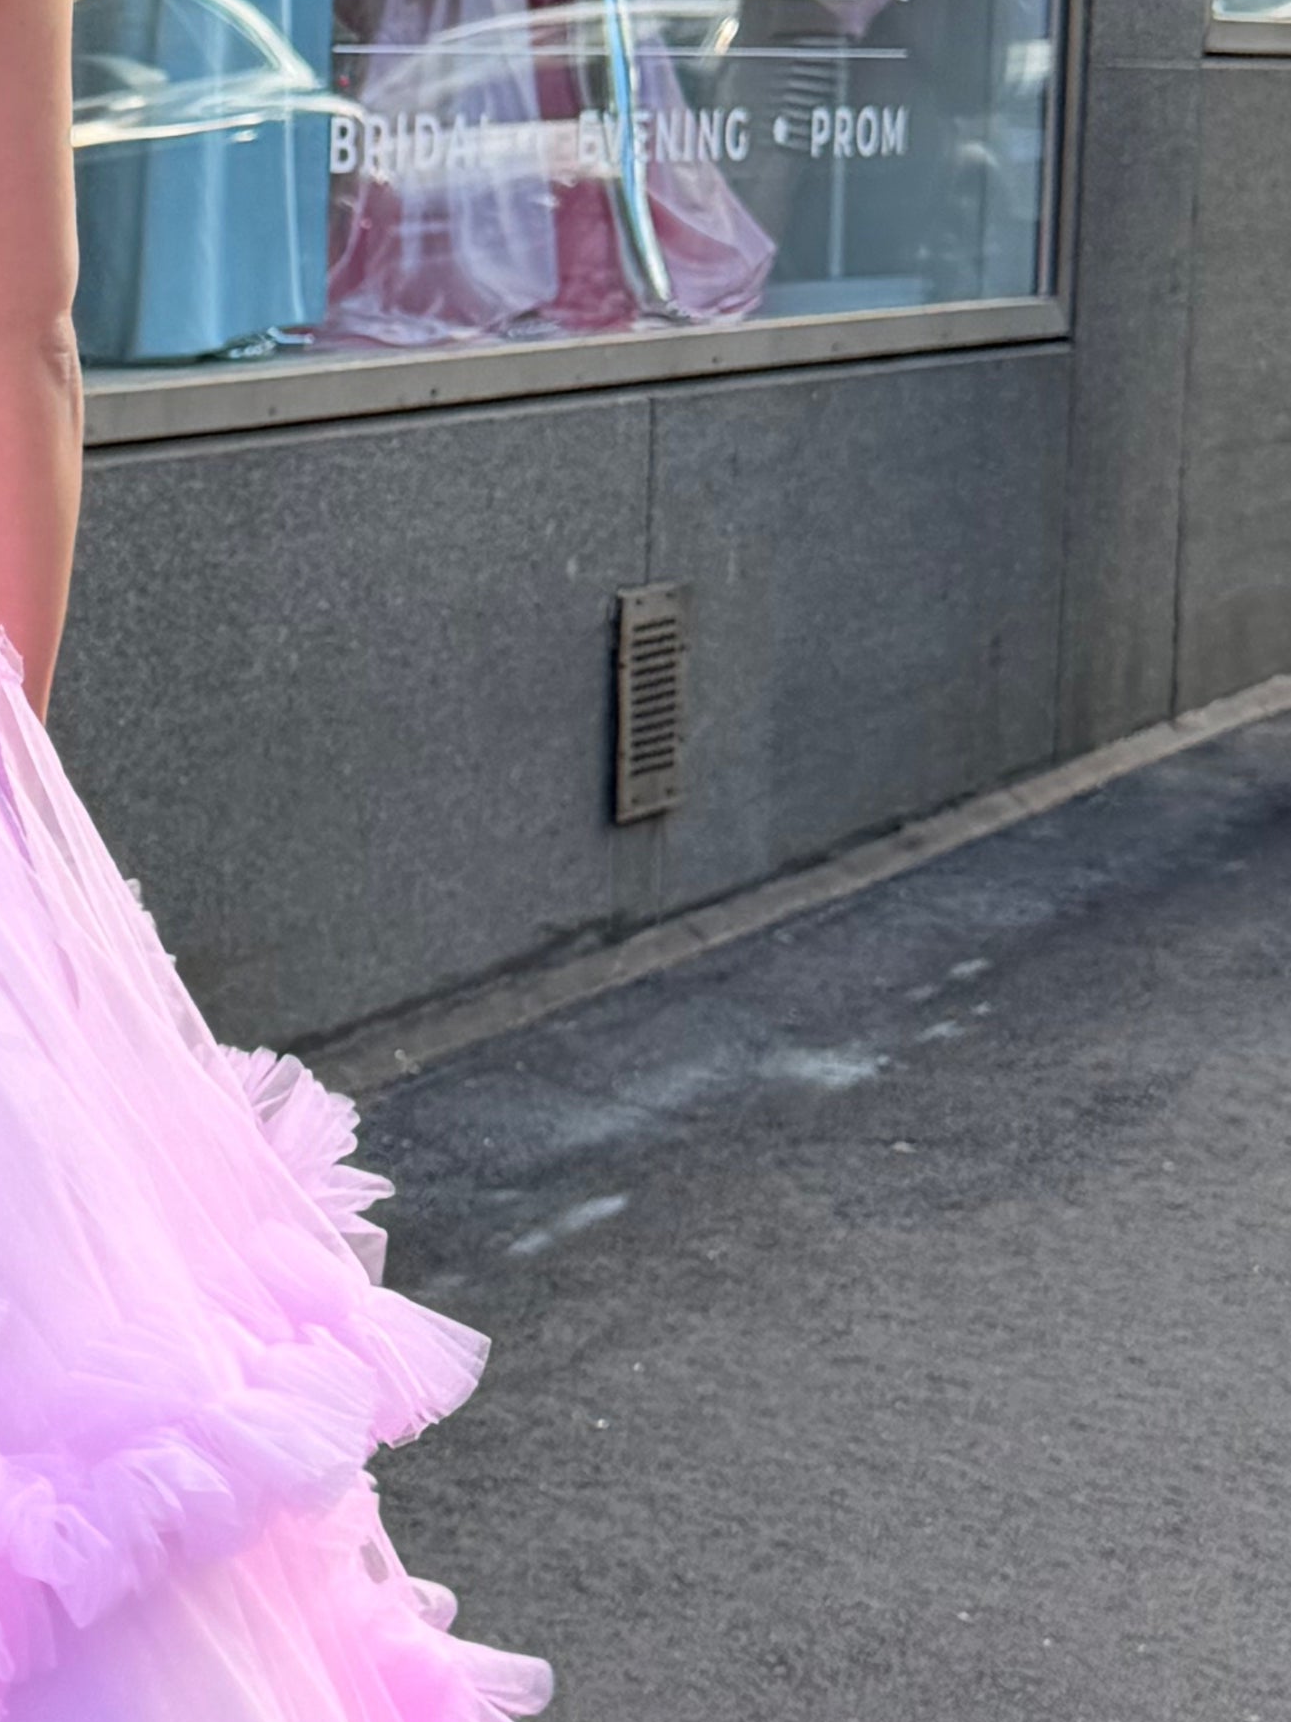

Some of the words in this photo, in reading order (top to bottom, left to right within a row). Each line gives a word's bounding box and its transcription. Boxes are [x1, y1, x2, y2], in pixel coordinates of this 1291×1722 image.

[330, 111, 500, 174] BRIDAL
[577, 108, 749, 163] EVENING
[810, 106, 905, 157] PROM
